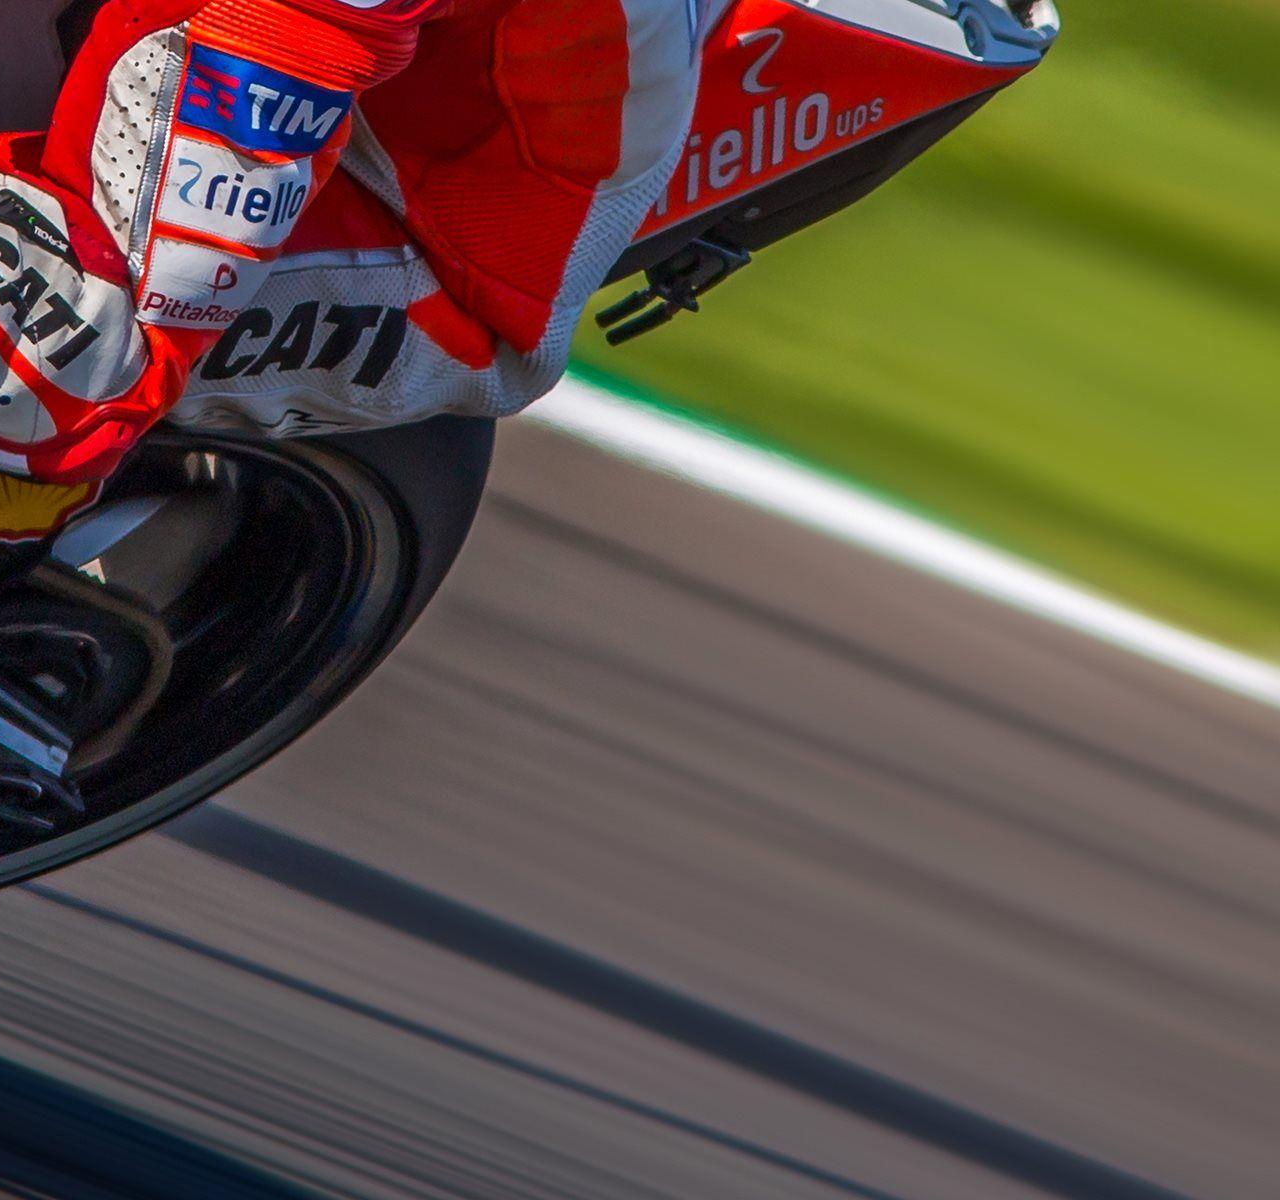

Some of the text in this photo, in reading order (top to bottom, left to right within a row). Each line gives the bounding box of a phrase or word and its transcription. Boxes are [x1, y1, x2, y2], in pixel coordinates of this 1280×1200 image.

[247, 83, 341, 140] TIM
[834, 96, 885, 138] ups
[204, 173, 307, 226] riello
